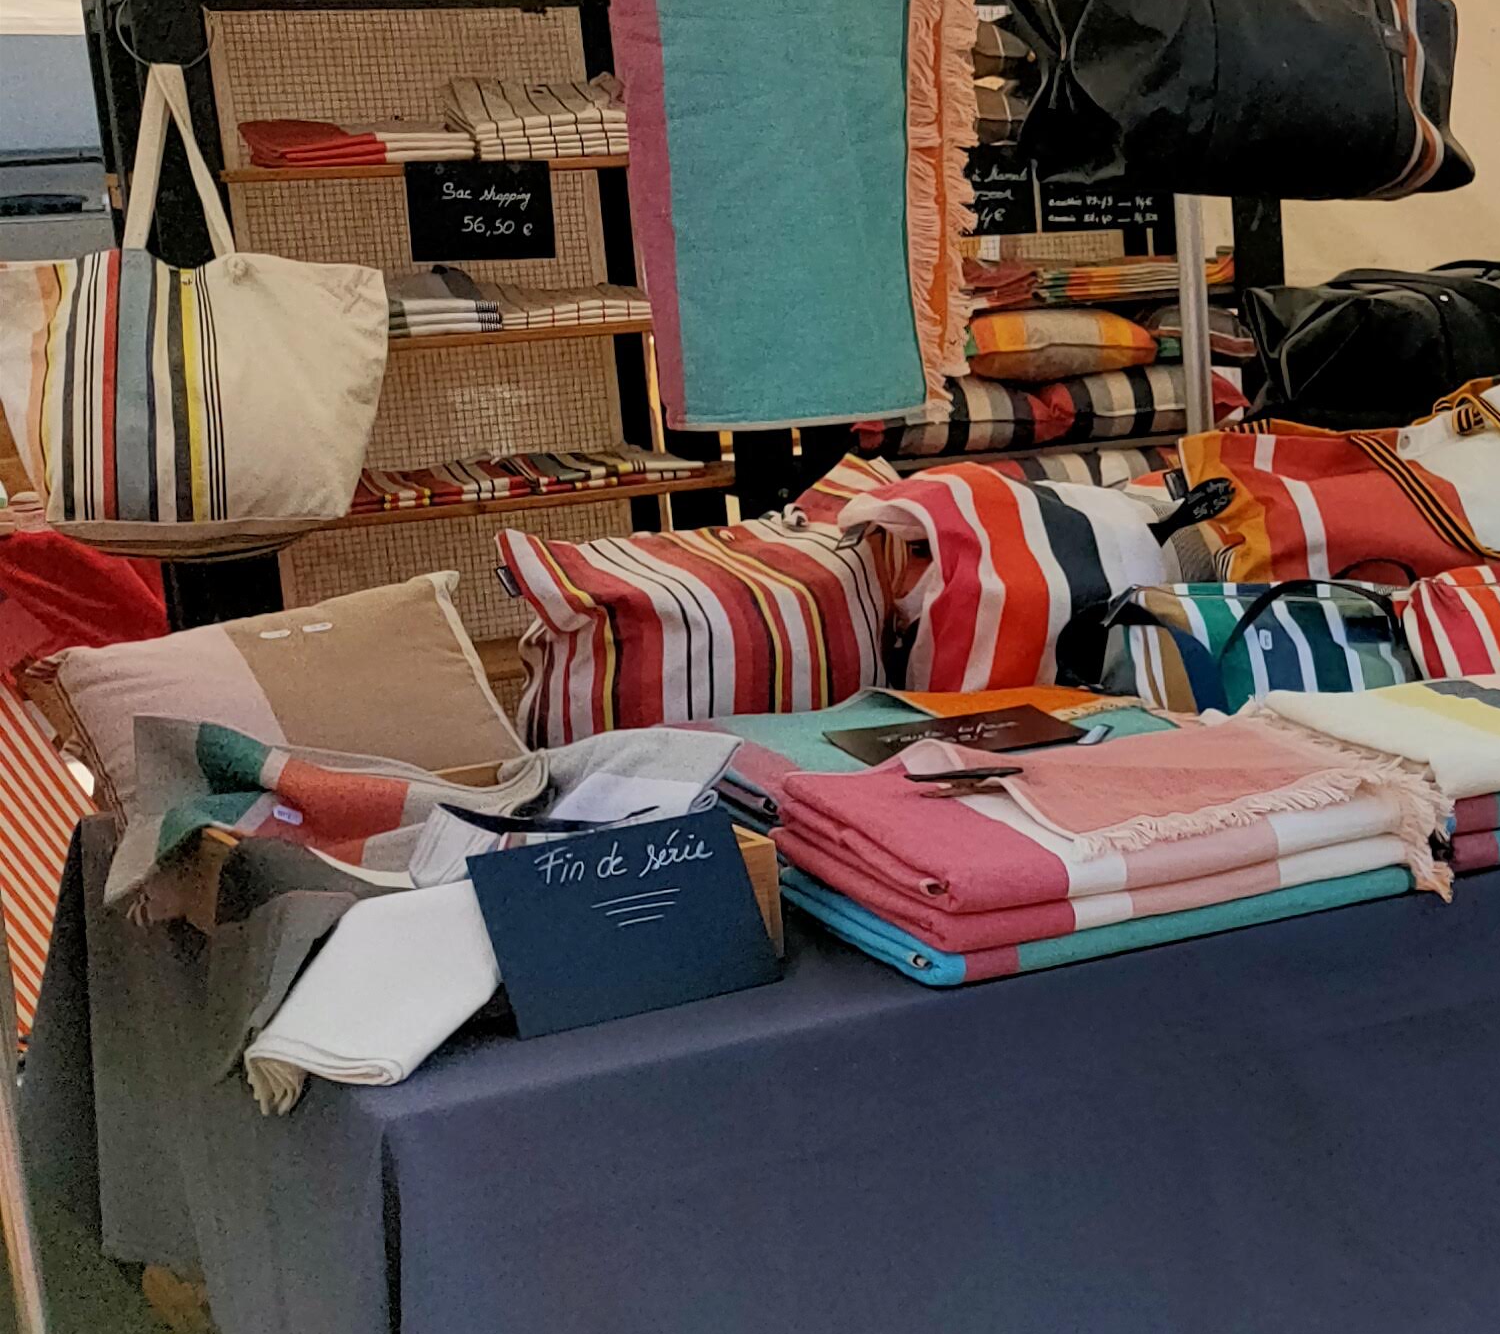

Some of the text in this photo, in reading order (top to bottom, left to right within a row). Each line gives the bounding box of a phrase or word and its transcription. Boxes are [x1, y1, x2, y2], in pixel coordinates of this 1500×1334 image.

[441, 182, 531, 211] Sac shopping
[461, 215, 515, 237] 56,50
[535, 829, 713, 884] Fin de série
